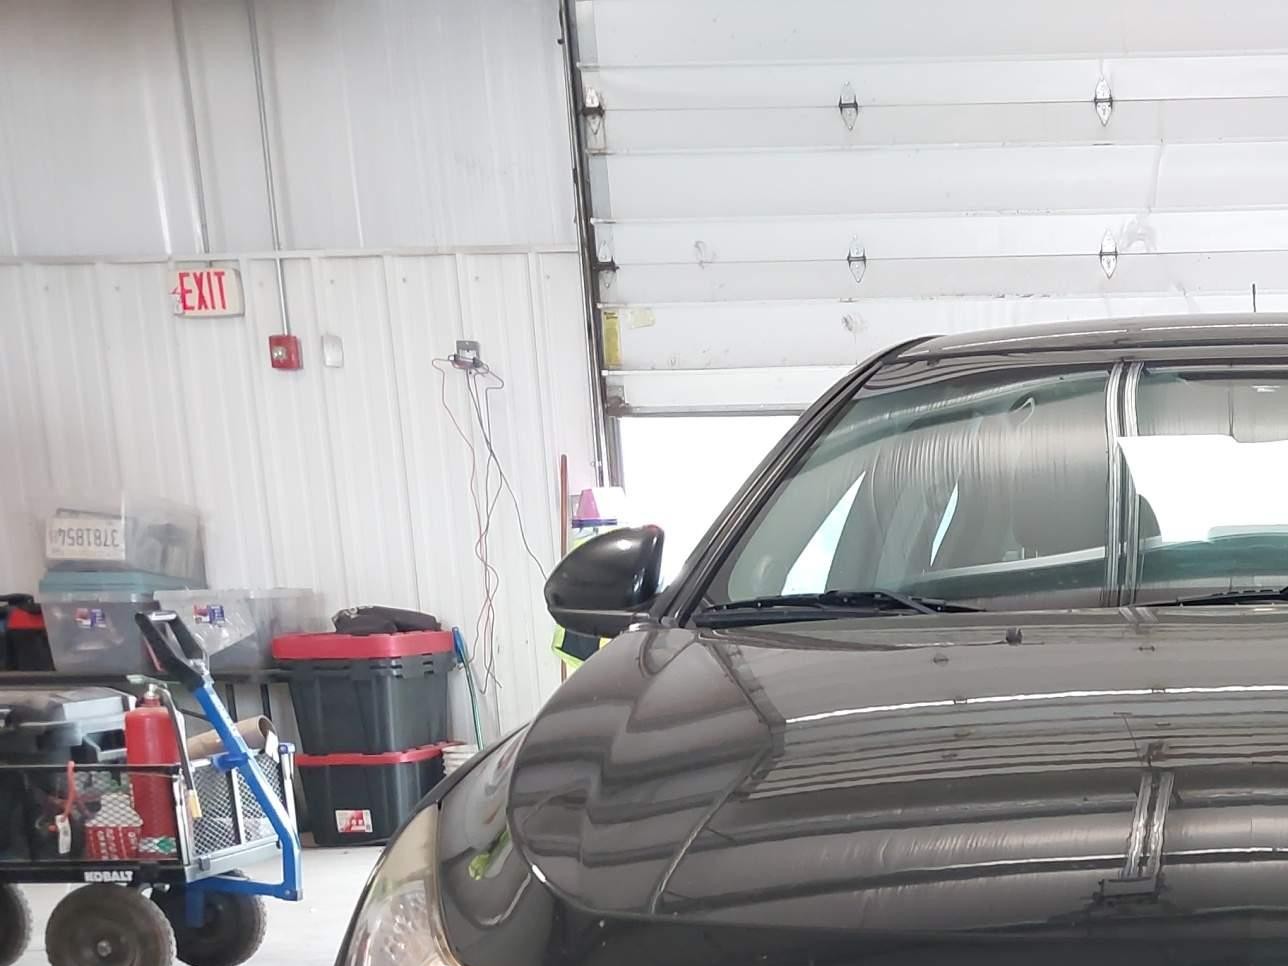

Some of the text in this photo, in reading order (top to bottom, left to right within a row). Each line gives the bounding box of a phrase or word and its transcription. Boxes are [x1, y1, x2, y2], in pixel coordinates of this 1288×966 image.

[179, 271, 227, 311] EXIT
[58, 527, 119, 548] 3781854
[84, 870, 134, 883] KOBALT
